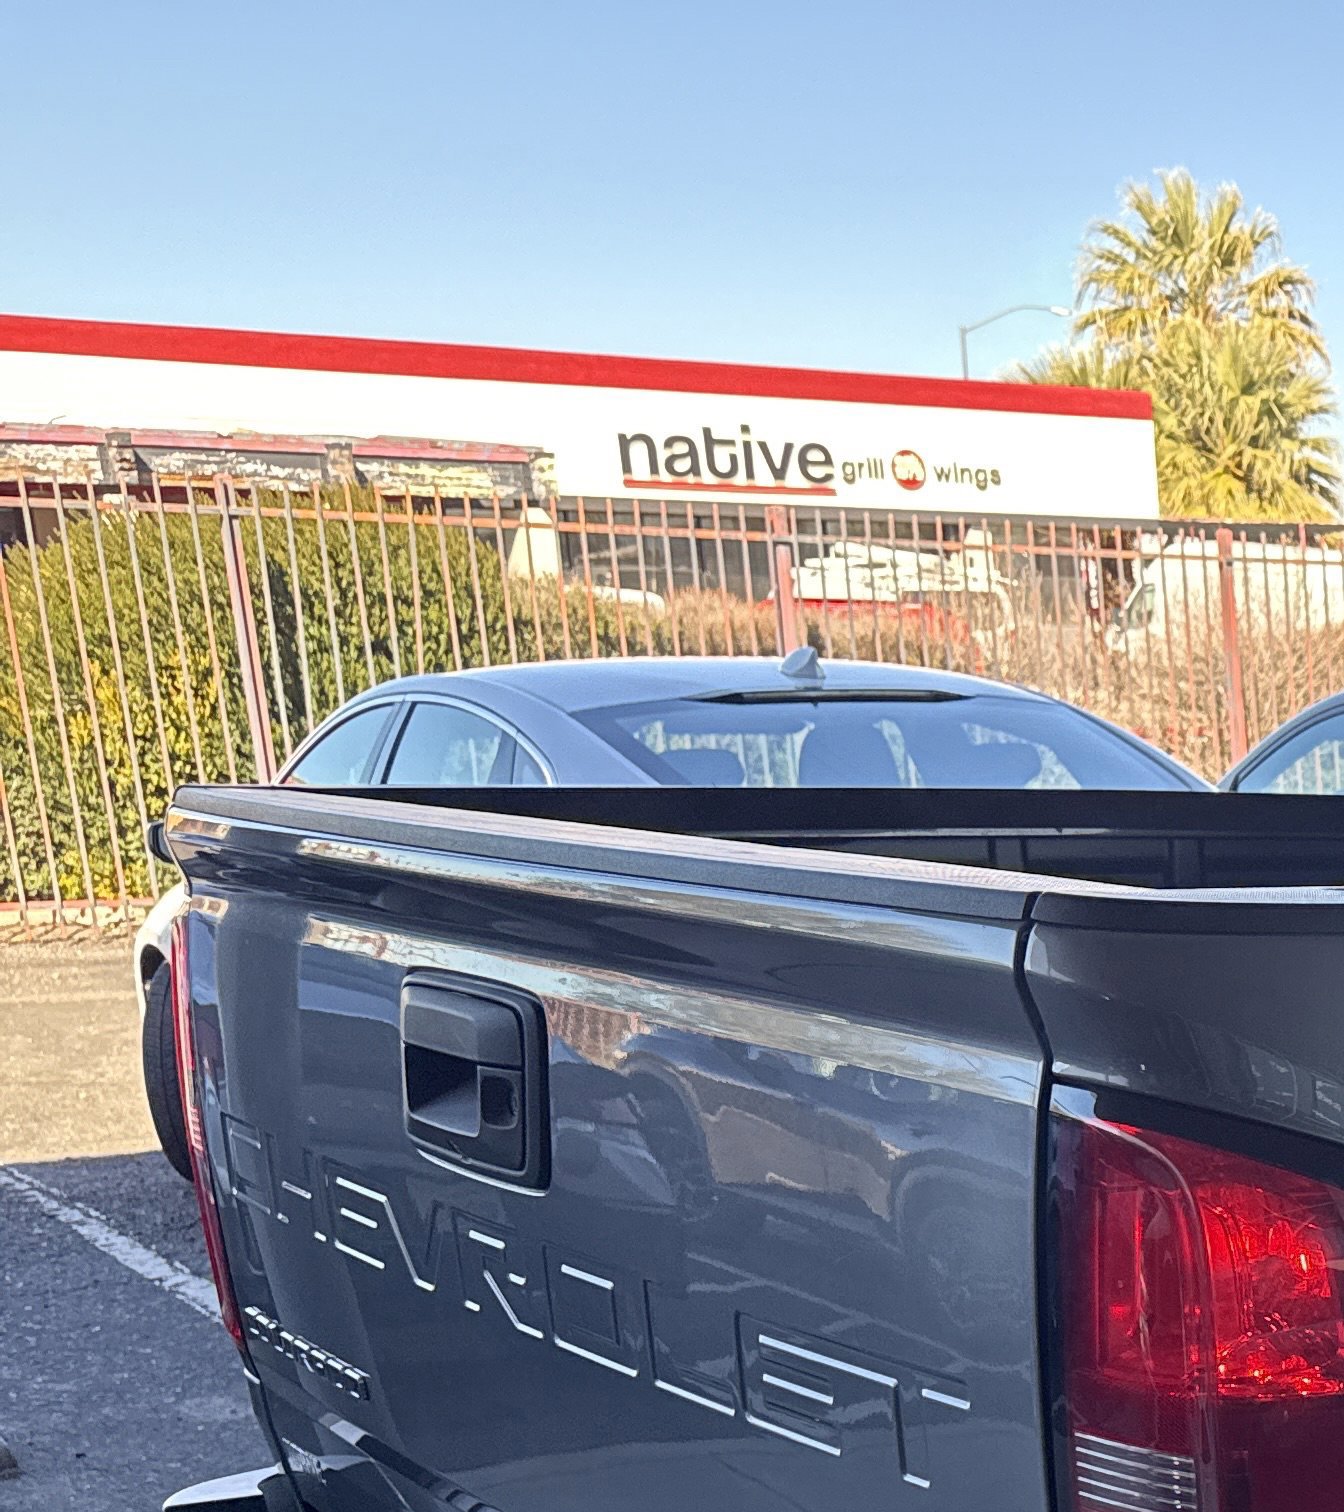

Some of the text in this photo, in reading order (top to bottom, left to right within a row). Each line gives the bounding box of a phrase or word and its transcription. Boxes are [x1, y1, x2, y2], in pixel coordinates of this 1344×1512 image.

[617, 423, 1002, 491] native grill wings
[220, 1111, 973, 1490] CHEVROLET
